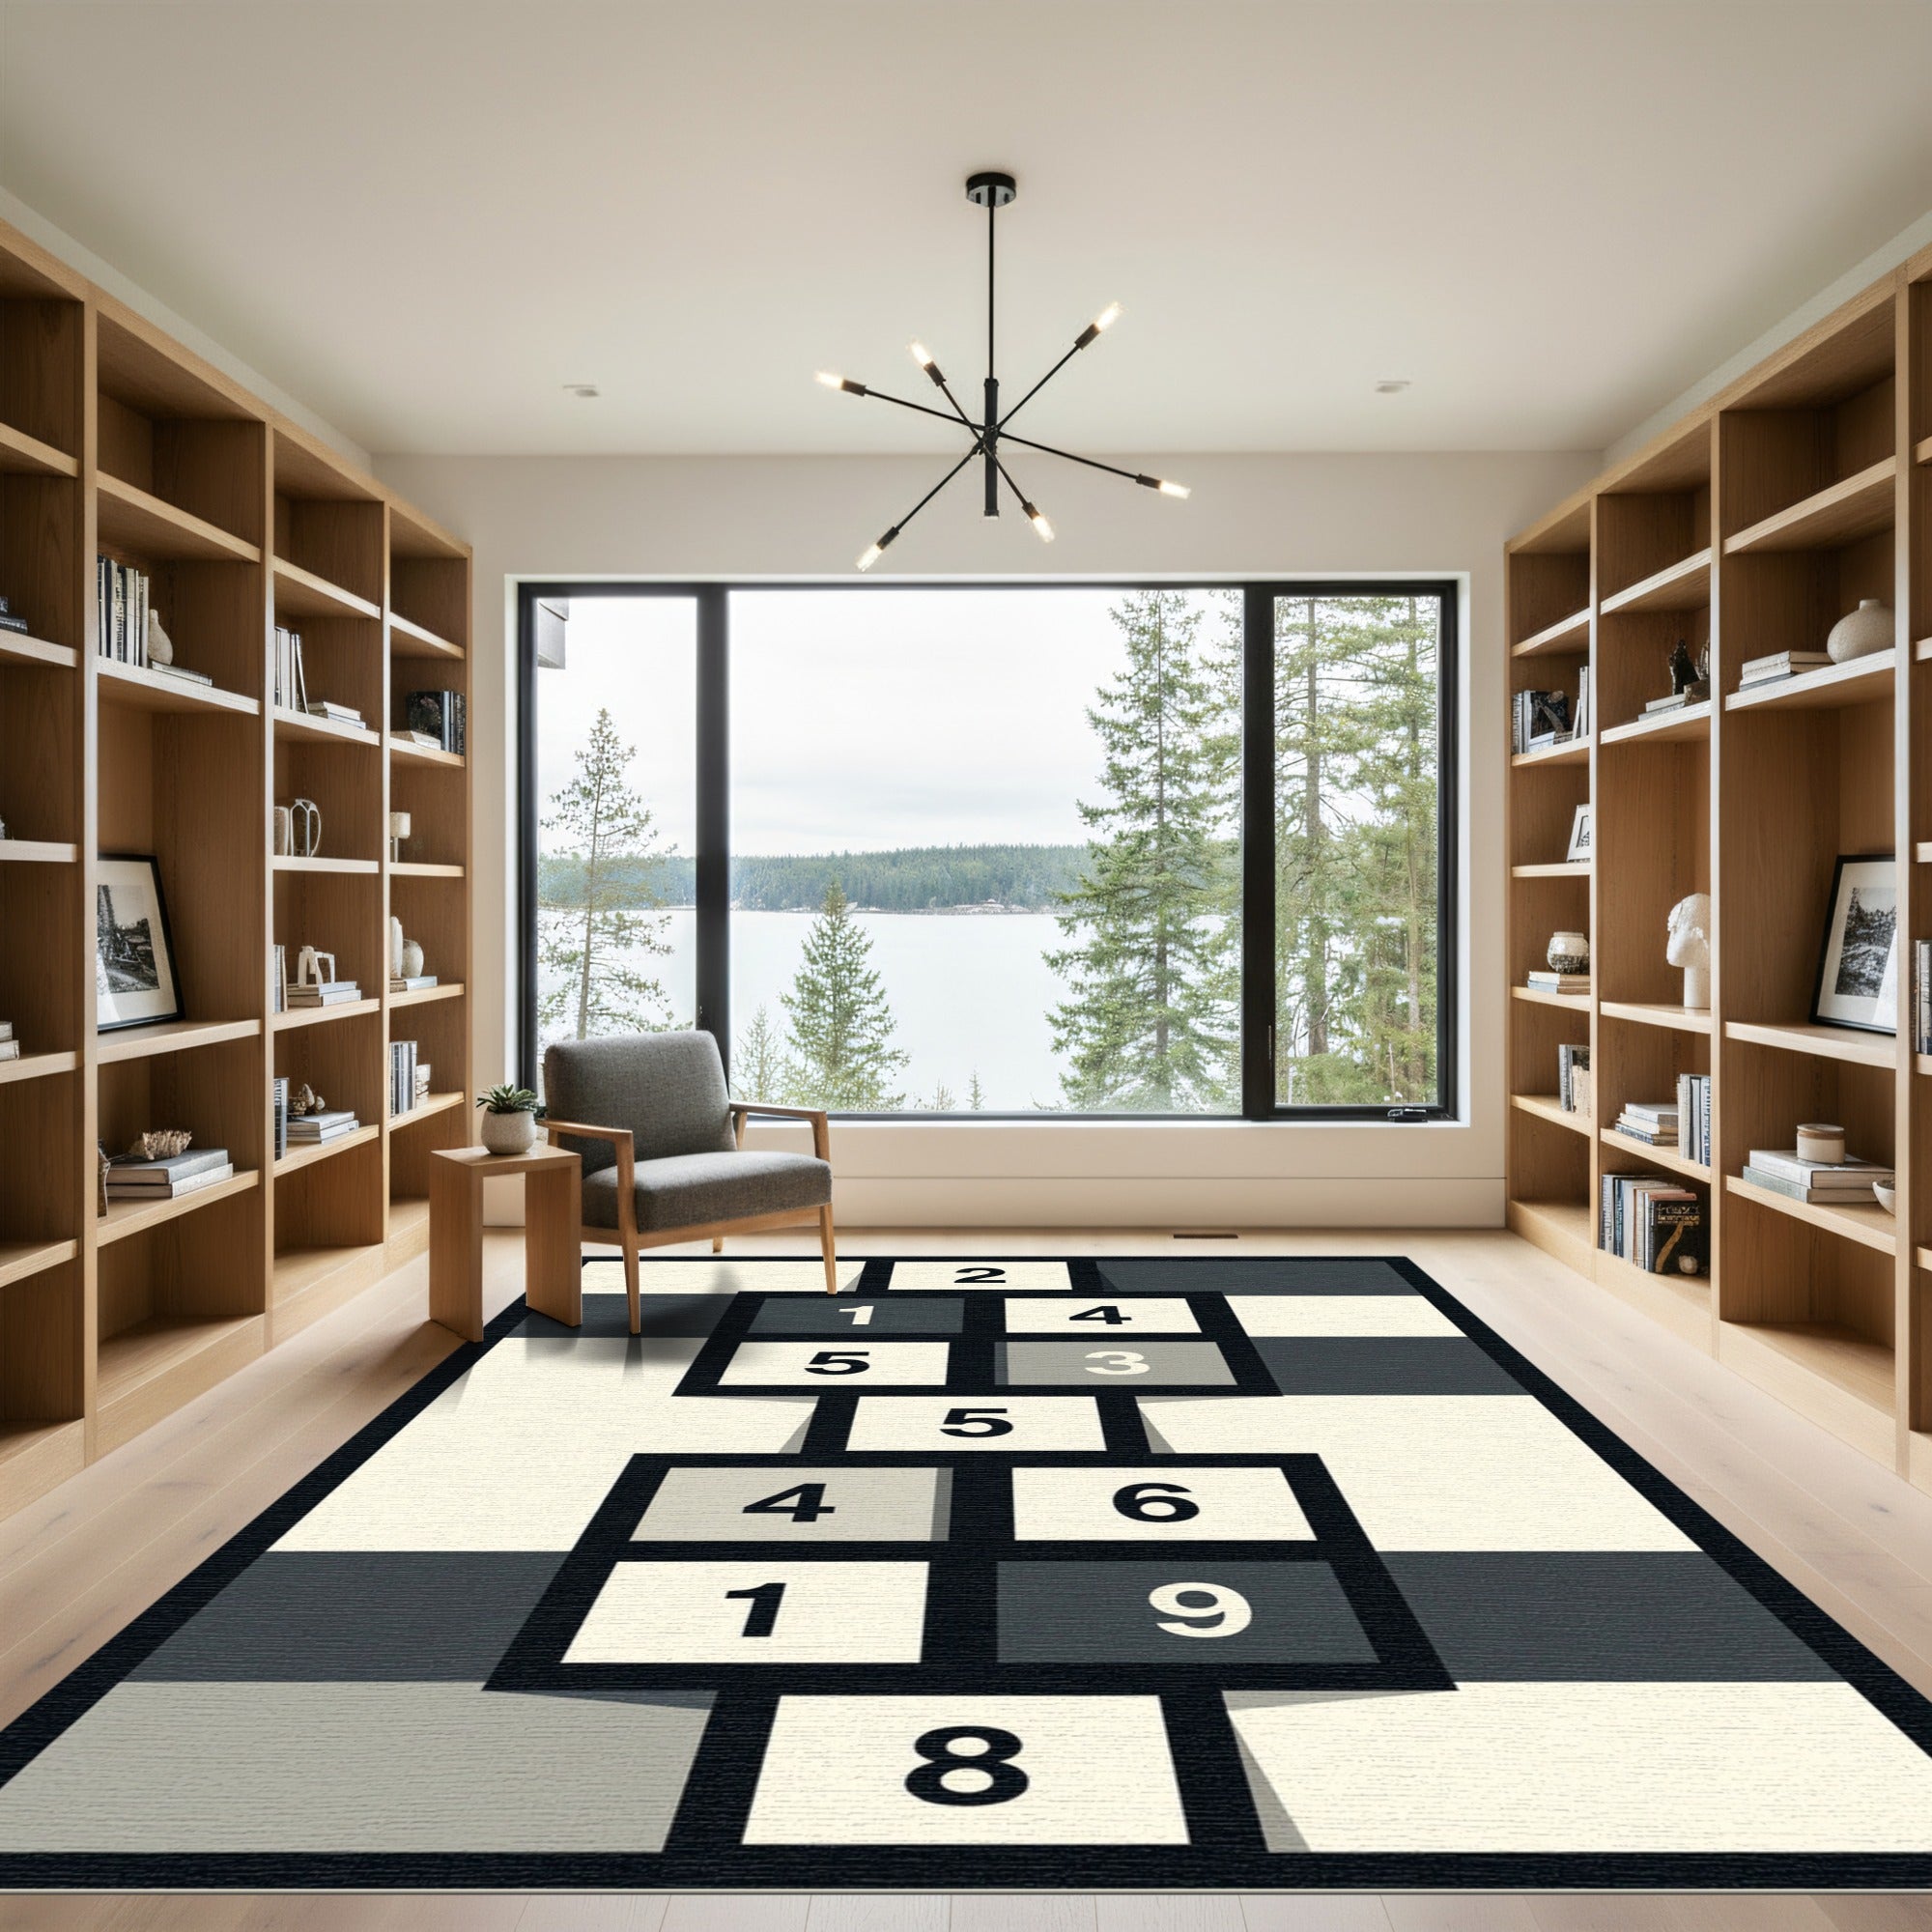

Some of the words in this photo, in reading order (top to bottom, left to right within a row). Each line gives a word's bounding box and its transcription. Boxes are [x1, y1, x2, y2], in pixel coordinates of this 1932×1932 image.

[954, 1268, 1006, 1284] 2
[838, 1305, 874, 1324] 1
[1068, 1305, 1131, 1324] 4
[804, 1351, 869, 1375] 5
[1084, 1350, 1150, 1375] 3
[940, 1408, 1013, 1437] 5
[743, 1483, 836, 1522] 4
[1113, 1483, 1200, 1522] 6
[725, 1582, 786, 1636] 1
[1149, 1582, 1252, 1637] 9
[905, 1726, 1029, 1806] 8
